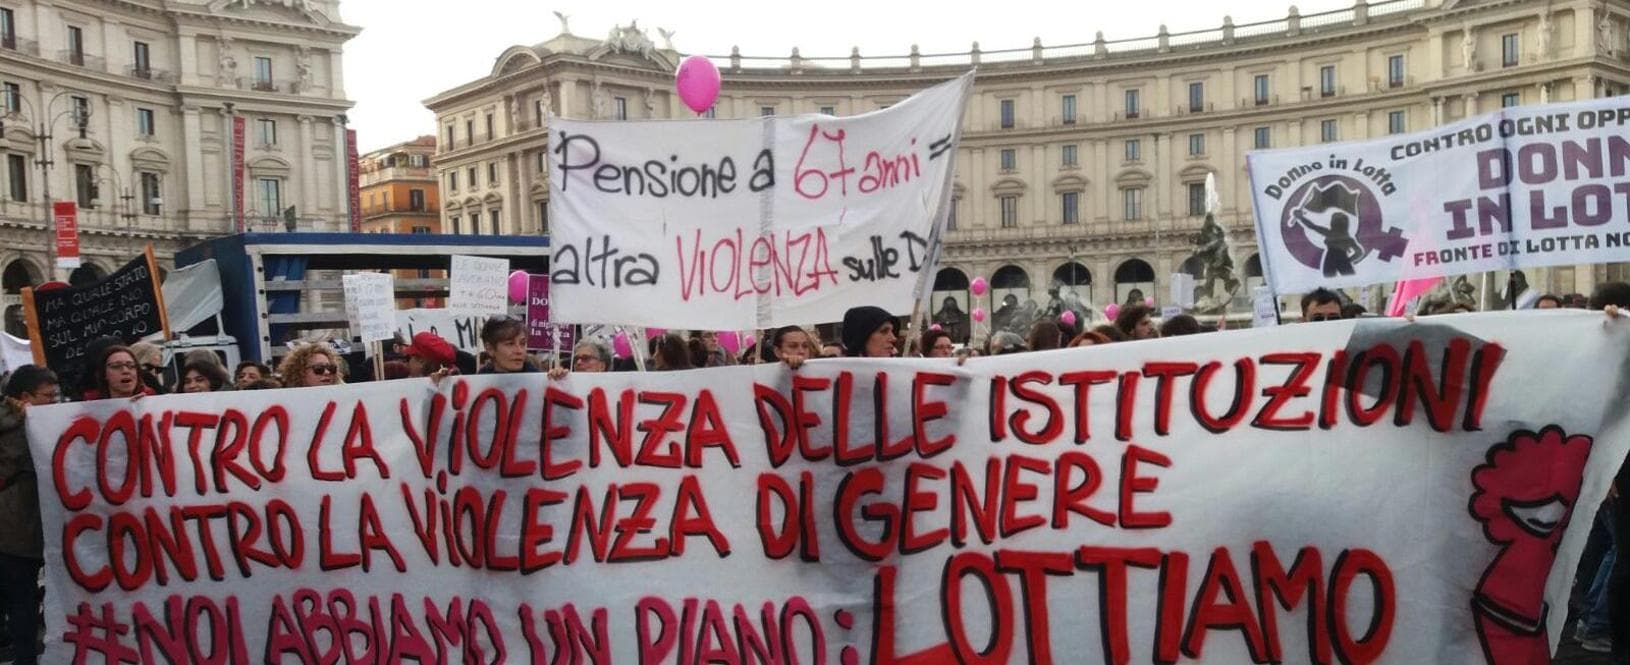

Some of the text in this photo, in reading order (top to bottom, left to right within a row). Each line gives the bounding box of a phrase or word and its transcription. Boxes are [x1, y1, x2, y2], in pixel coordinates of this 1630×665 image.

[1391, 123, 1493, 161] CONTRO
[1499, 112, 1569, 138] OGNI
[554, 131, 737, 199] Pensione
[749, 148, 776, 192] a
[794, 123, 855, 200] 67
[859, 138, 921, 194] anni
[1329, 153, 1347, 170] in
[1444, 192, 1513, 240] IN
[551, 233, 660, 290] altra
[842, 235, 900, 282] sulle
[1414, 243, 1492, 267] FRONTE
[1498, 240, 1520, 255] DI
[1526, 235, 1600, 254] LOTTA
[72, 282, 113, 306] QUALE
[114, 265, 147, 291] STATO
[46, 316, 67, 332] MA
[71, 301, 115, 323] QUALE
[48, 330, 78, 348] SUL
[52, 403, 291, 512] CONTRO
[307, 400, 391, 481] LA
[753, 371, 957, 466] DELLE
[989, 337, 1505, 445] ISTITUZIONI
[63, 498, 305, 592] CONTRO
[318, 491, 406, 573] LA
[756, 469, 820, 562] DI
[834, 444, 1173, 562] GENERE
[64, 594, 250, 665] #NOI
[264, 587, 507, 665] ABBIAMO
[518, 602, 612, 665] UN
[872, 540, 1396, 665] LOTTIAMO
